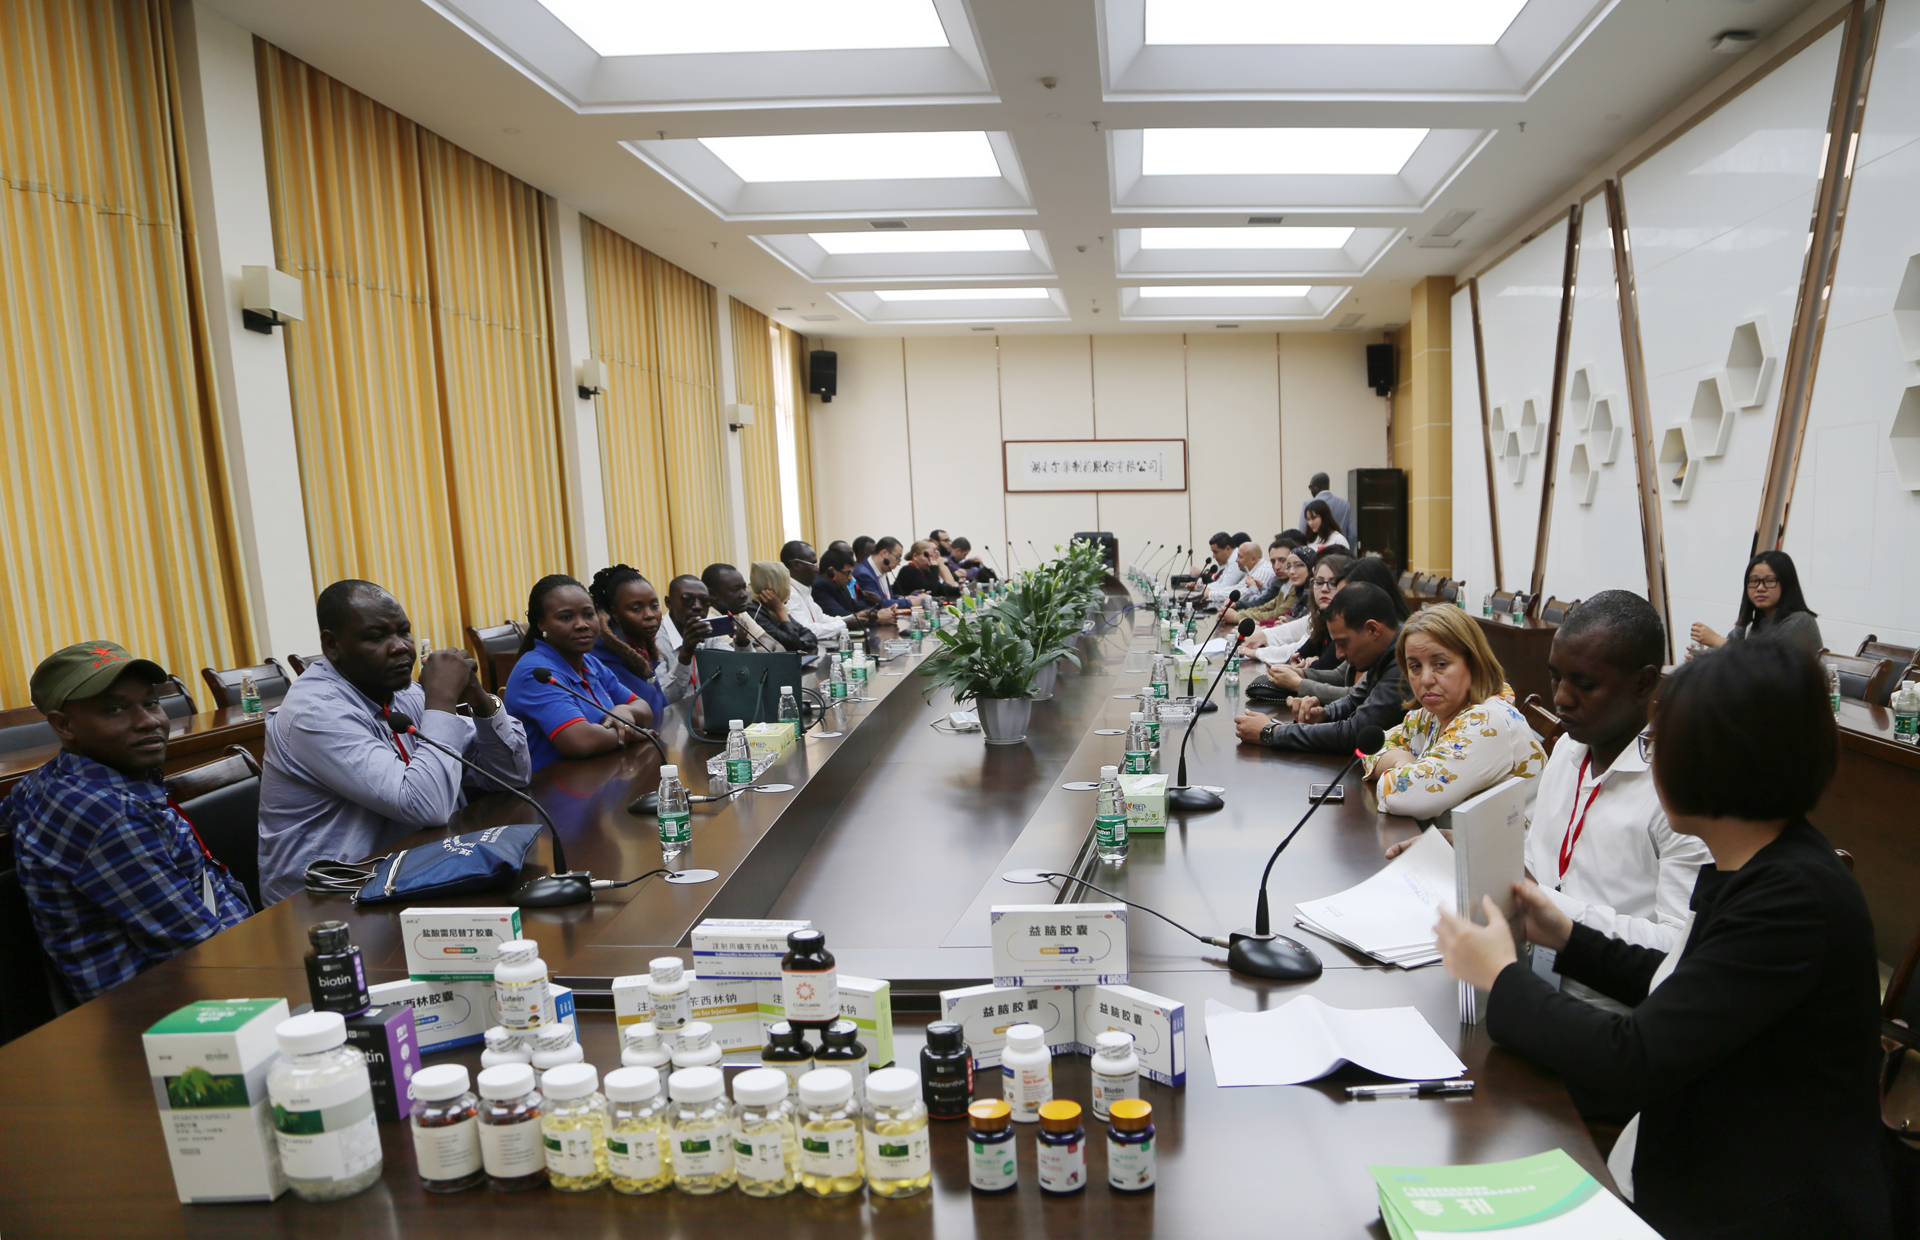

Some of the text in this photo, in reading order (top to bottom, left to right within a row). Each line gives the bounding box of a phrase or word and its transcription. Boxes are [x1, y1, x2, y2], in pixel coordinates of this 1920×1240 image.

[422, 928, 494, 938] 盐酸雷尼替丁胶囊
[1029, 924, 1088, 937] 益脑胶囊
[318, 974, 352, 988] biotin
[501, 994, 525, 1002] Lutein
[711, 1007, 737, 1016] Injection
[983, 999, 1039, 1018] 益脑胶囊
[1099, 1002, 1143, 1026] 益脑胶囊
[928, 1079, 965, 1089] astaxanthin
[1104, 1086, 1125, 1094] Biotin
